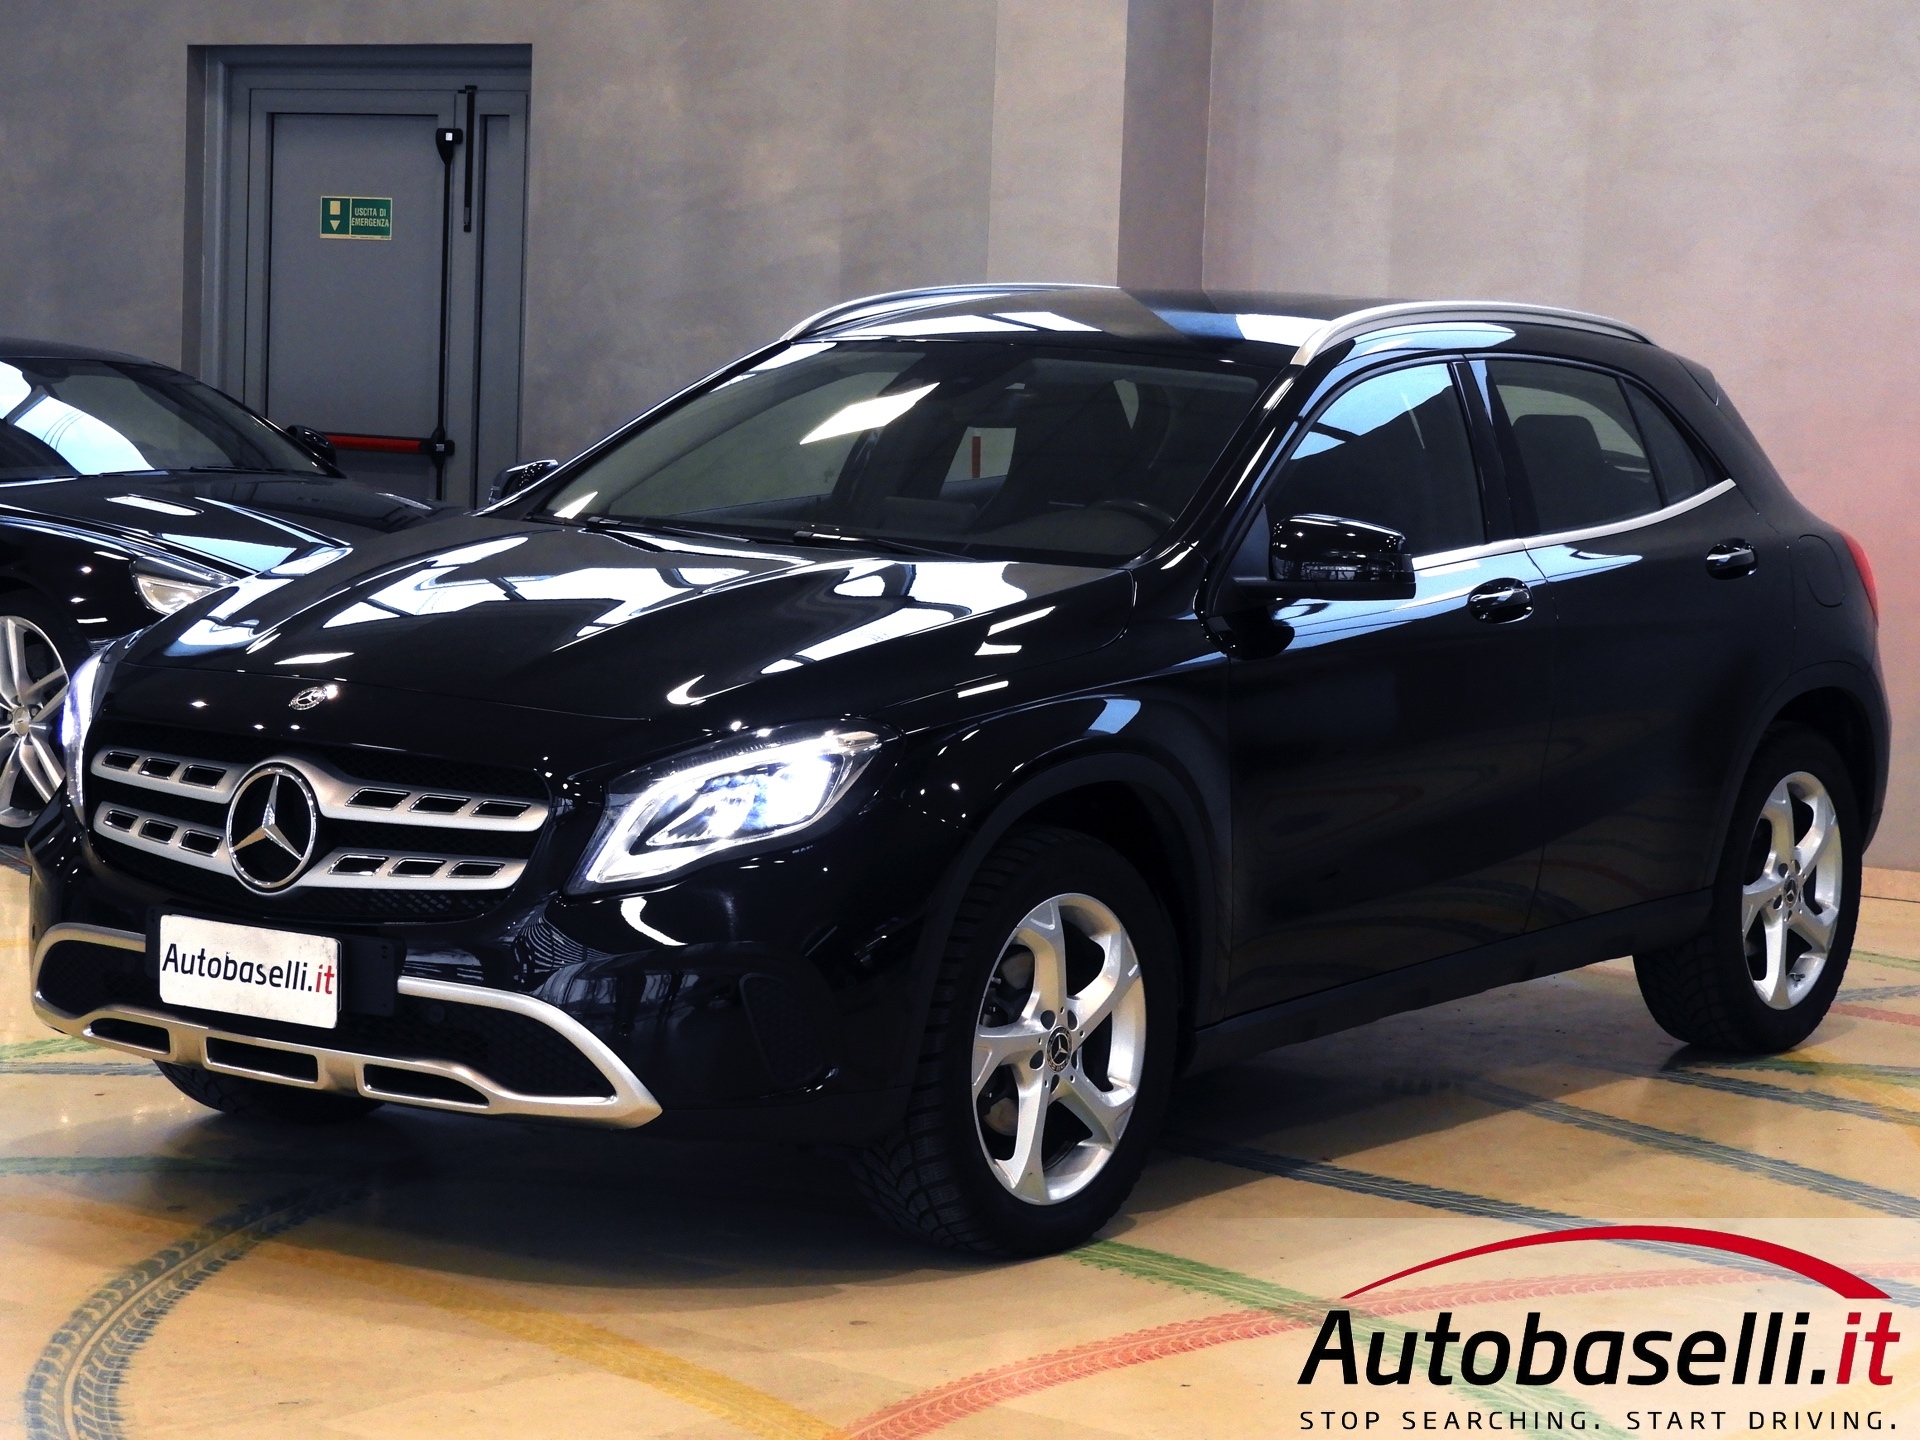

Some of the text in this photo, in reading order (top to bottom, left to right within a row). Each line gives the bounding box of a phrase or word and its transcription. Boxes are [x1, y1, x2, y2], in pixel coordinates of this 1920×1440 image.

[355, 208, 386, 217] USCITA DI
[351, 219, 389, 227] EMERGENZA
[162, 943, 335, 995] Autobaselli.it
